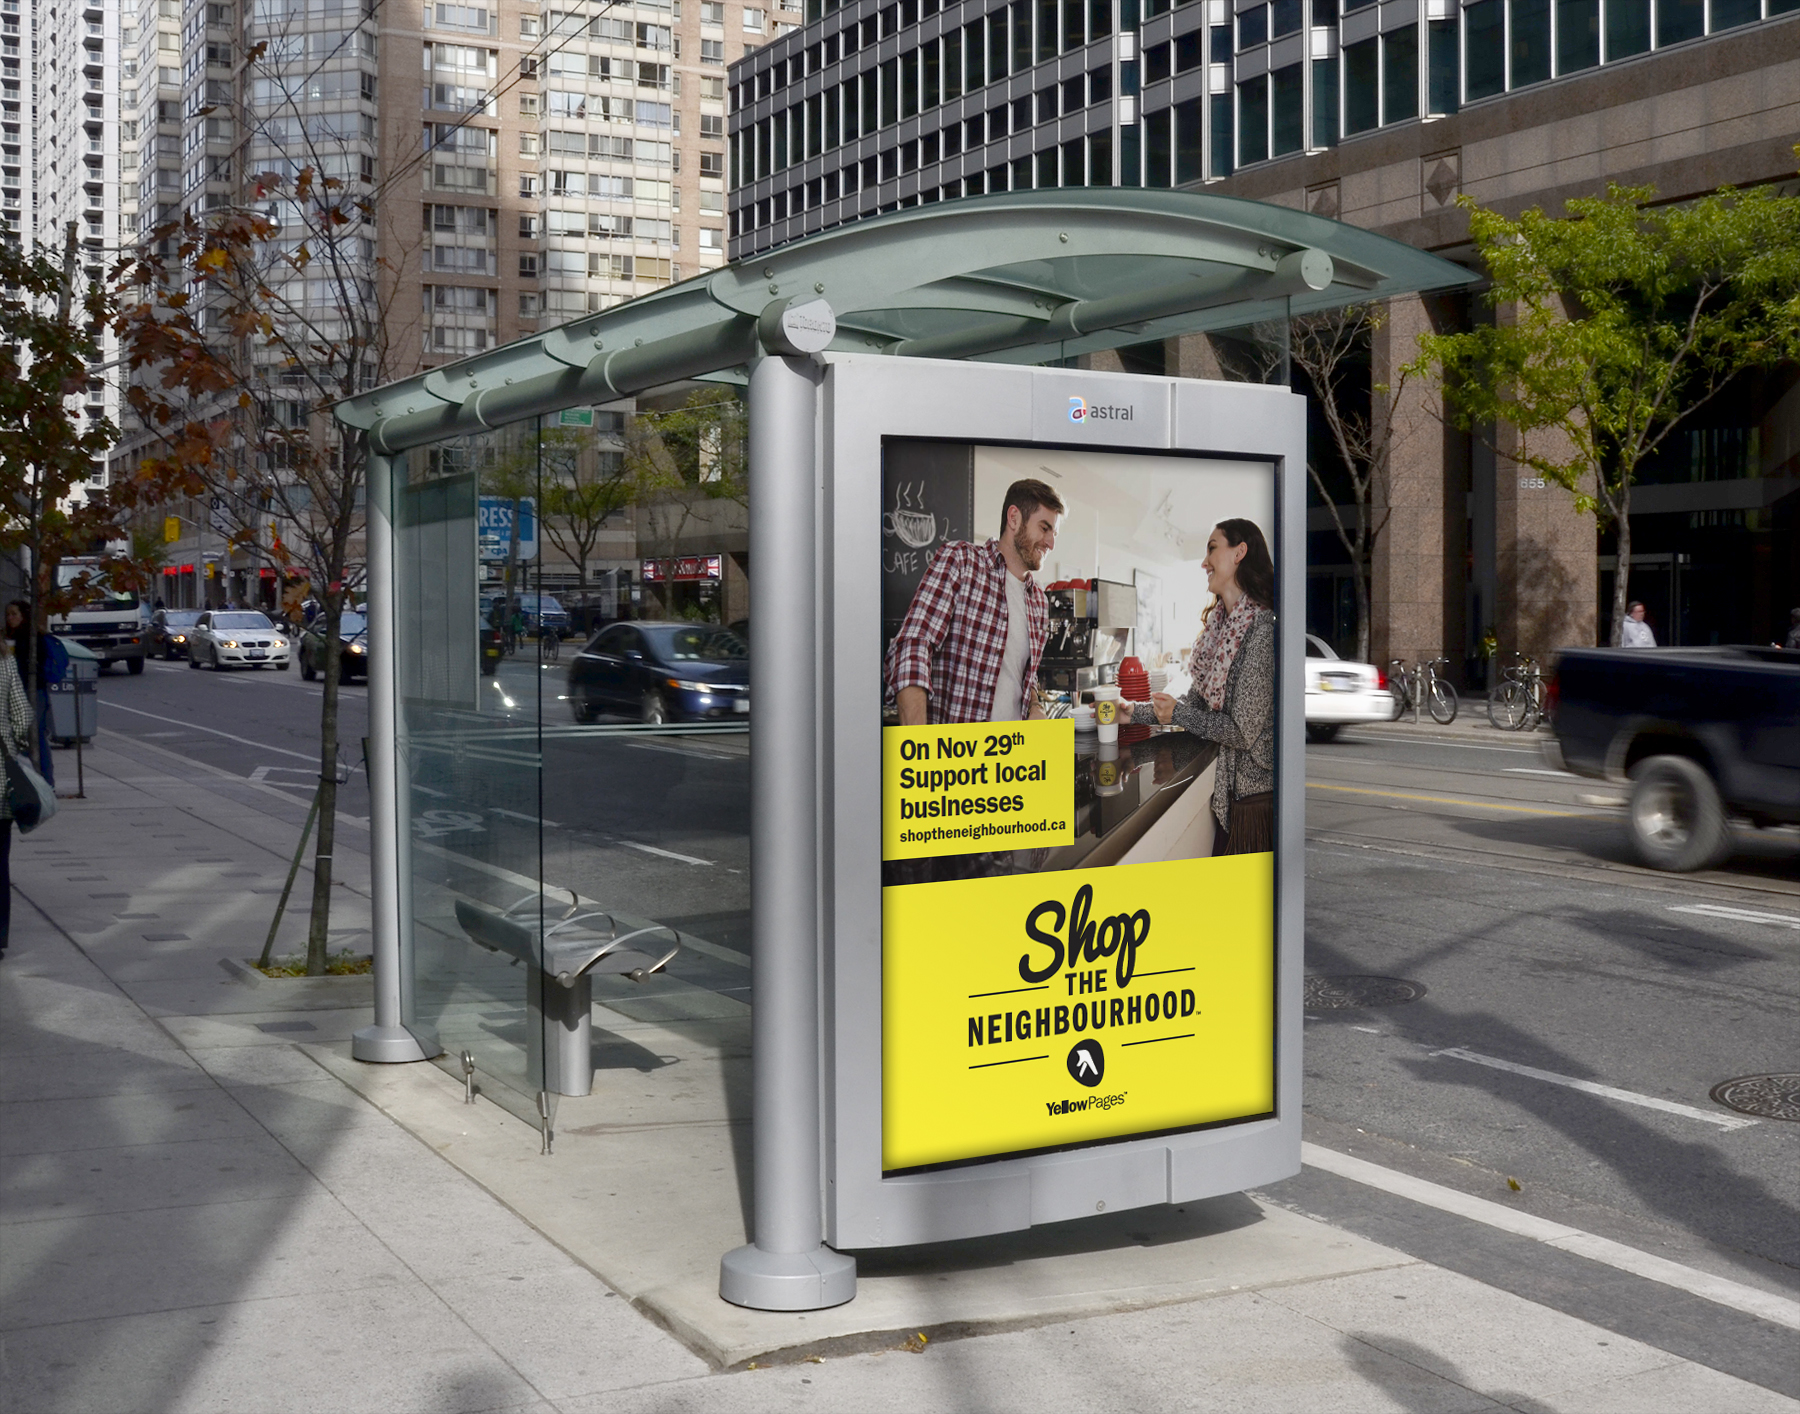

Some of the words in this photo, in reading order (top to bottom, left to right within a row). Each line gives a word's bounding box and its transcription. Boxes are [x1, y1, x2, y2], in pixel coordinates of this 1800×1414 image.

[1090, 405, 1133, 421] astral
[900, 739, 930, 761] On
[937, 736, 978, 759] Nov
[984, 731, 1025, 757] 29th
[900, 763, 988, 792] Support
[995, 759, 1047, 784] local
[900, 794, 1025, 820] businesses
[899, 819, 1066, 843] shoptheneighbourhood.ca
[1018, 883, 1151, 989] Shop
[1064, 968, 1108, 996] THE
